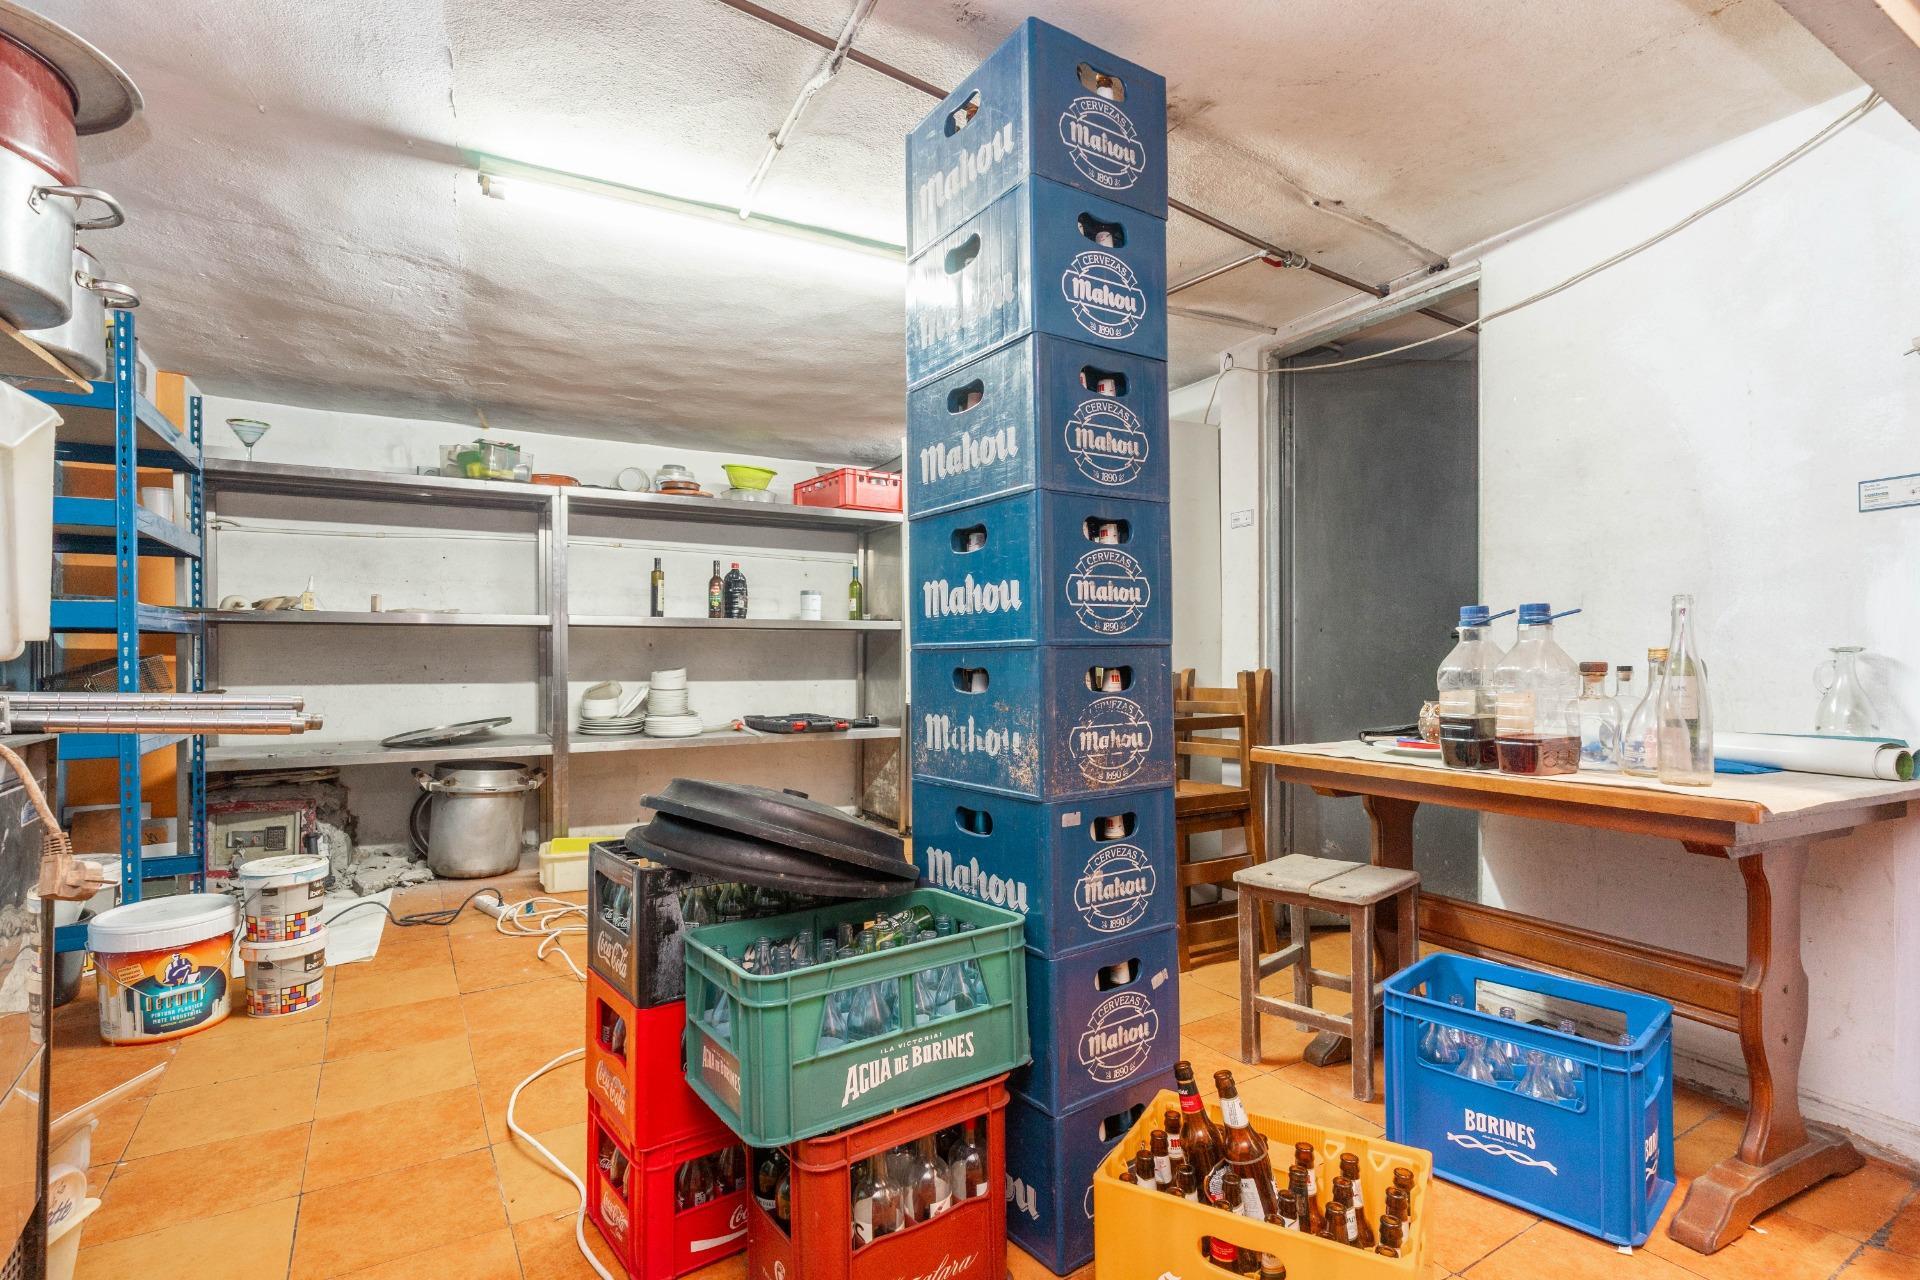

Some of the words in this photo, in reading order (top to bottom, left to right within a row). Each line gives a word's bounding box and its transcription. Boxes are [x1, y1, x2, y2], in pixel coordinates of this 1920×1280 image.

[1081, 101, 1127, 127] CERVEZAS
[1070, 121, 1136, 165] Mahou
[920, 122, 1015, 216] Mahou
[1096, 173, 1113, 186] 1890
[1082, 254, 1127, 277] CERVEZAS
[1072, 277, 1137, 312] Mahou
[1097, 325, 1115, 337] 1890
[1085, 402, 1130, 423] CERVEZAS
[1075, 427, 1139, 456] Mahou
[920, 426, 1019, 485] Mahou
[1101, 470, 1118, 482] 1890
[1086, 551, 1132, 569] CERVEZAS
[923, 574, 1022, 618] Mahou
[1076, 579, 1142, 603] Mahou
[1102, 620, 1119, 632] 1890
[1079, 728, 1144, 752] Mahou
[1094, 846, 1138, 867] CERVEZAS
[927, 846, 1029, 915] Mahou
[1085, 873, 1147, 904] Mahou
[1108, 917, 1125, 929] 1890
[1098, 996, 1141, 1018] CERVEZAS
[1088, 1021, 1150, 1057] Mahou
[841, 1056, 893, 1108] AGUA
[894, 1055, 909, 1076] DE
[912, 1031, 975, 1068] BORINES
[1112, 1065, 1129, 1078] 1890
[1464, 1108, 1536, 1150] BORINES
